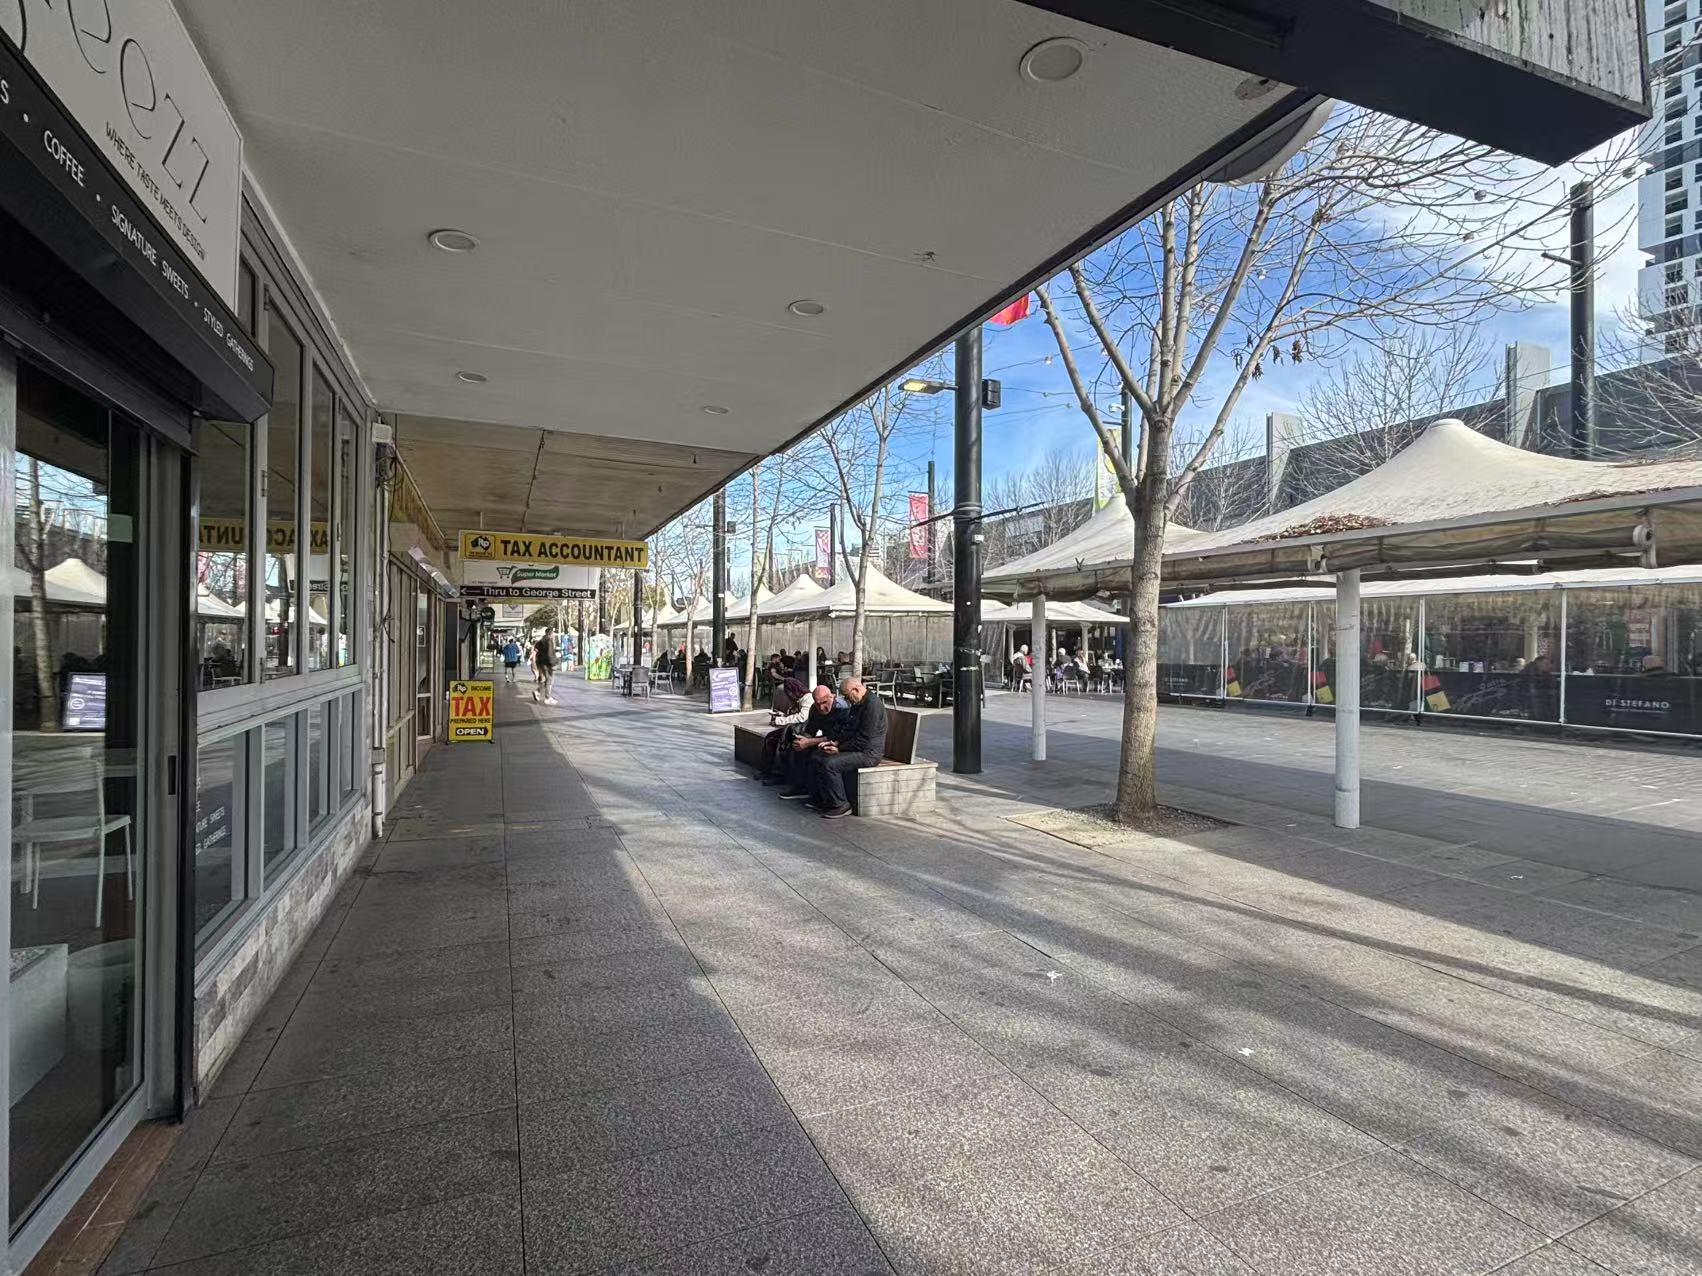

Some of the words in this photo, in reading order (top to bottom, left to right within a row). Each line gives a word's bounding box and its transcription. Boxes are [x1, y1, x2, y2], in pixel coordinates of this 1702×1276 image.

[106, 120, 136, 170] WHERE
[136, 161, 160, 201] TASTE
[160, 192, 183, 231] MEETS
[43, 130, 85, 188] COFFEE
[111, 204, 157, 267] SIGNATURE
[161, 260, 189, 299] SWEETS
[203, 308, 224, 338] STYLED
[500, 539, 533, 557] TAX
[537, 542, 645, 563] ACCOUNTANT
[516, 570, 534, 578] Super
[482, 586, 506, 596] Thru
[509, 587, 520, 596] to
[522, 588, 559, 599] George
[562, 588, 592, 598] Street
[452, 696, 491, 716] TAX
[1605, 698, 1616, 706] DI
[1620, 699, 1670, 709] STEFANO
